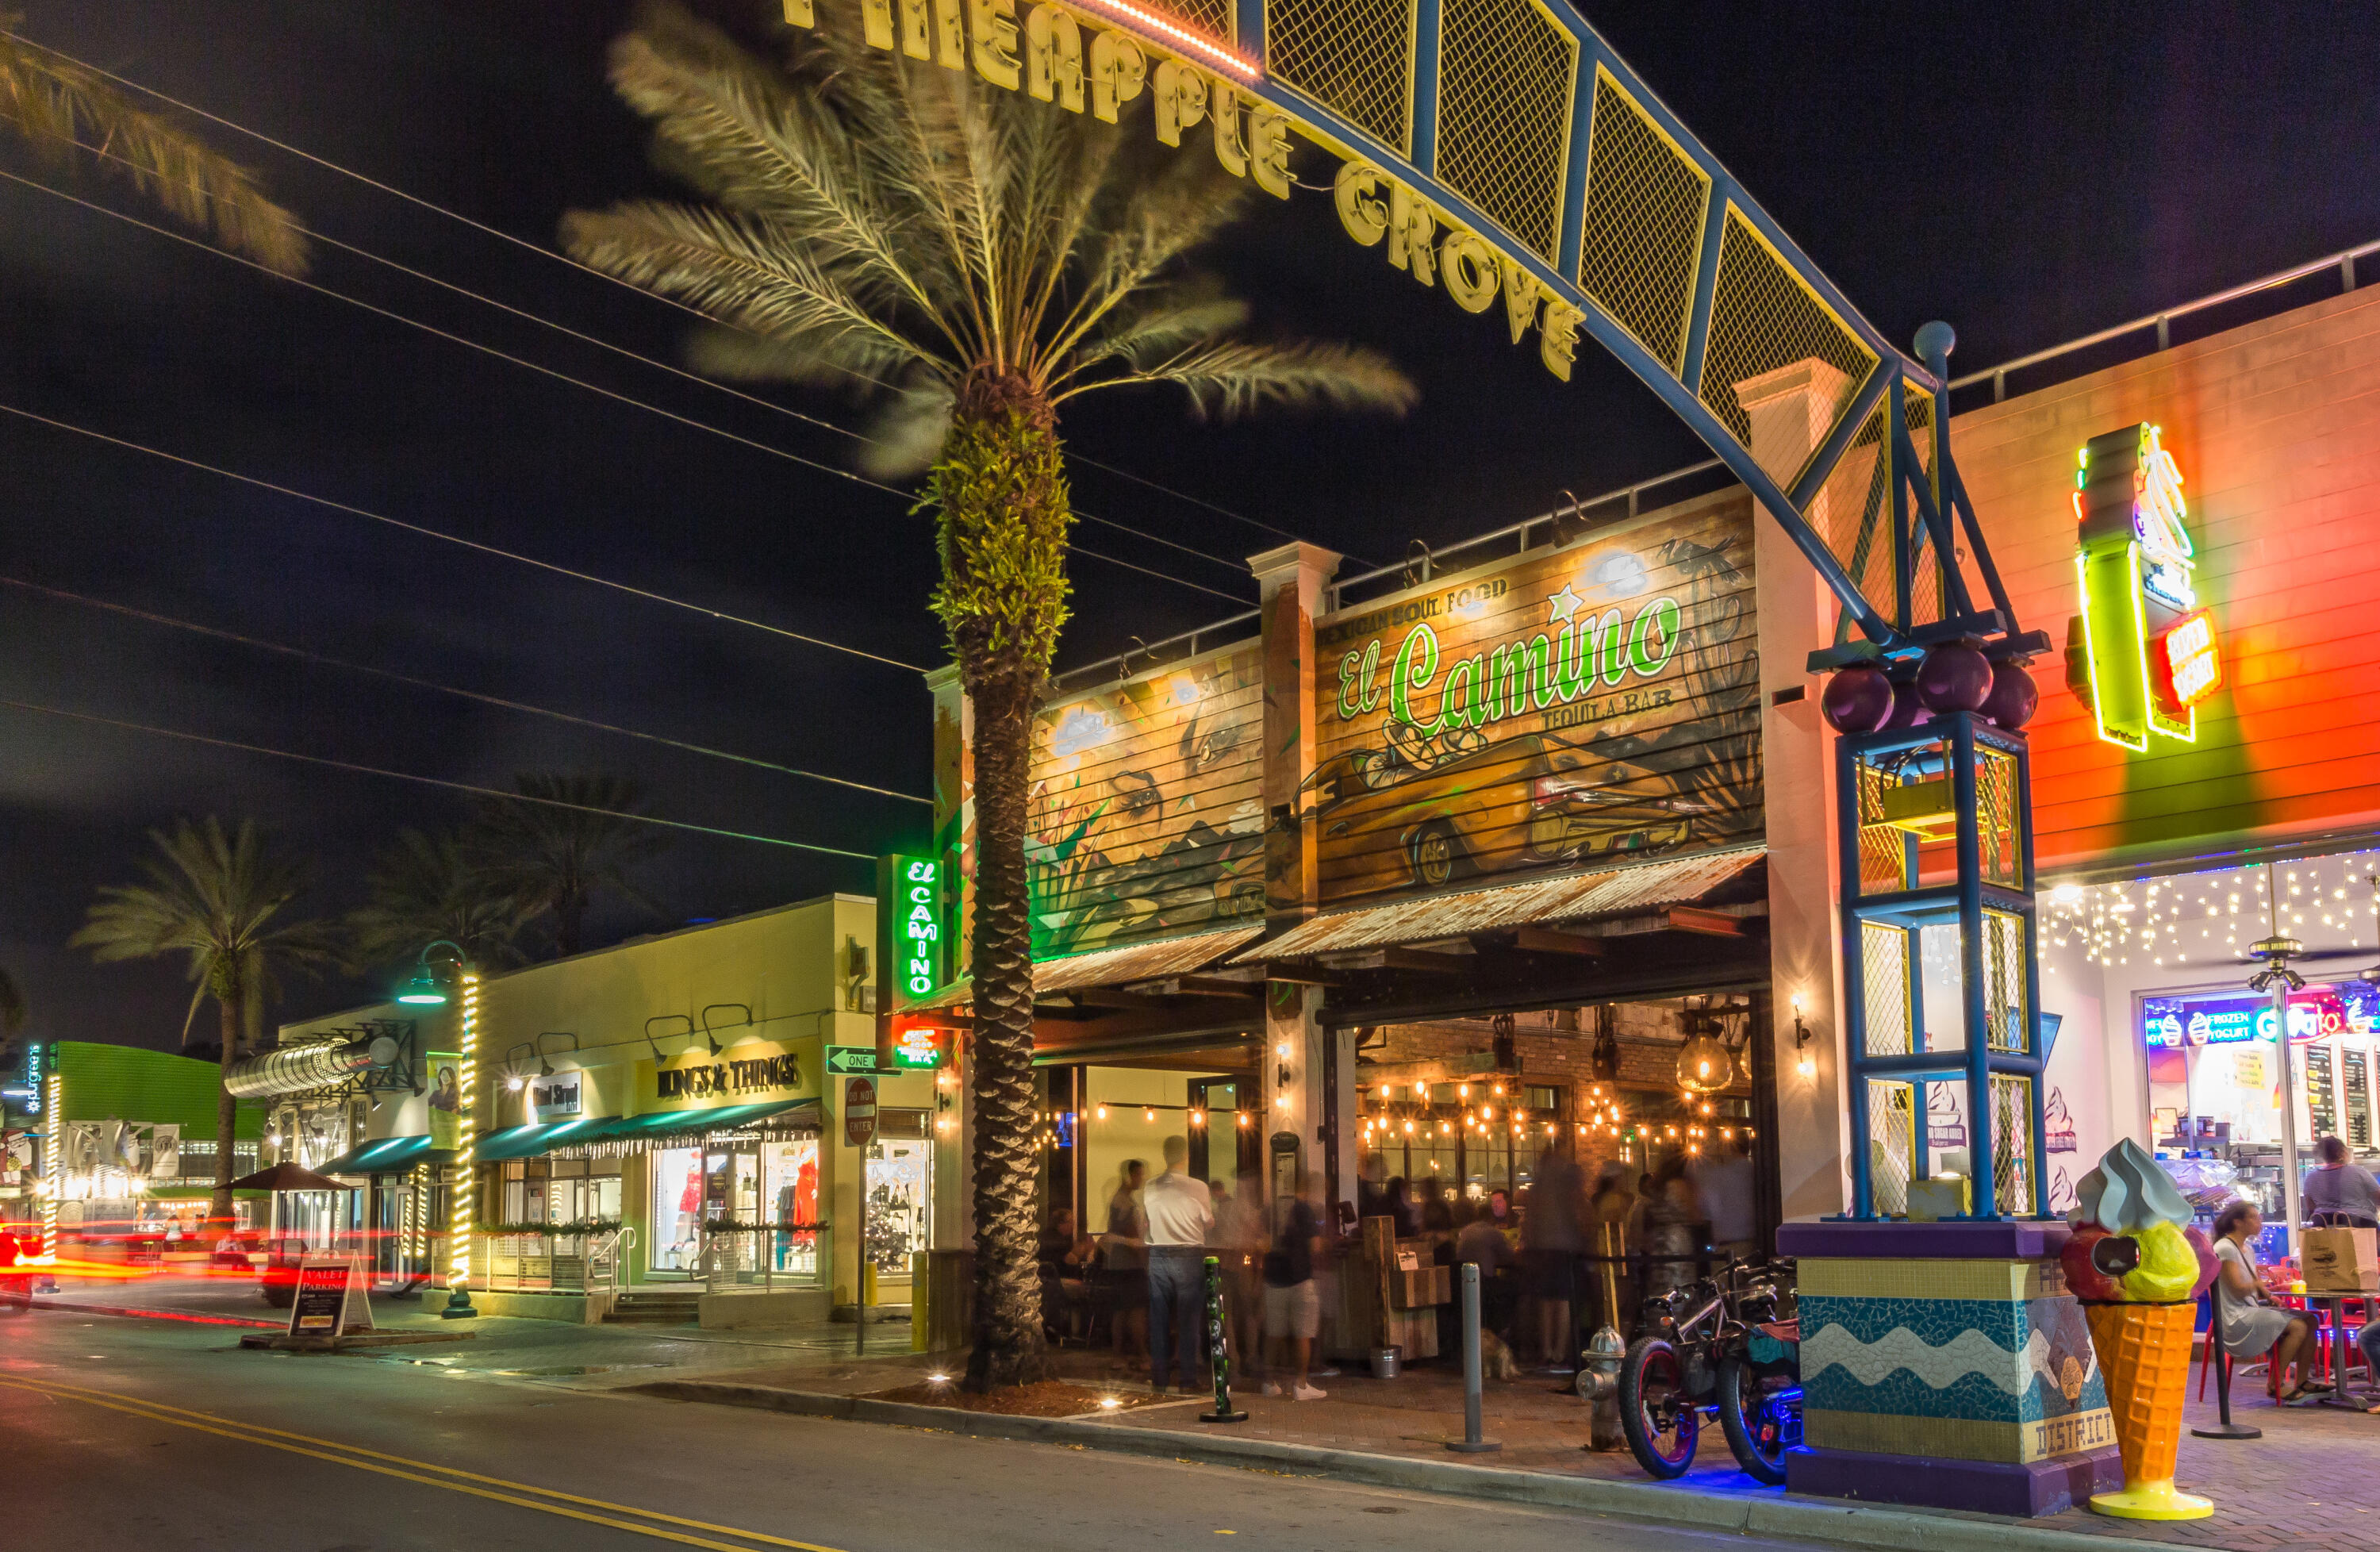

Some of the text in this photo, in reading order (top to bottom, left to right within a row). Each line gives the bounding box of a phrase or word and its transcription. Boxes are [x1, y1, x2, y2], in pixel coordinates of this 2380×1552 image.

[782, 0, 1584, 382] INEAPPLE GROVE
[1392, 597, 1441, 626] SOUL
[1447, 578, 1507, 612] FOOD
[1338, 585, 1681, 740] El Camino
[1541, 688, 1675, 731] TEQUILA BAR
[908, 862, 935, 882] El
[908, 886, 938, 993] CAMINO
[2207, 1012, 2250, 1024] FROZEN
[2208, 1027, 2250, 1039] YOGURT
[849, 1055, 869, 1066] ONE
[712, 1063, 727, 1092] &
[729, 1054, 799, 1089] THINGS
[849, 1090, 873, 1102] DO NOT
[850, 1120, 872, 1132] ENTER
[307, 1270, 345, 1279] VALET
[302, 1282, 344, 1291] PARKING
[2036, 1412, 2111, 1455] DISTRICT
